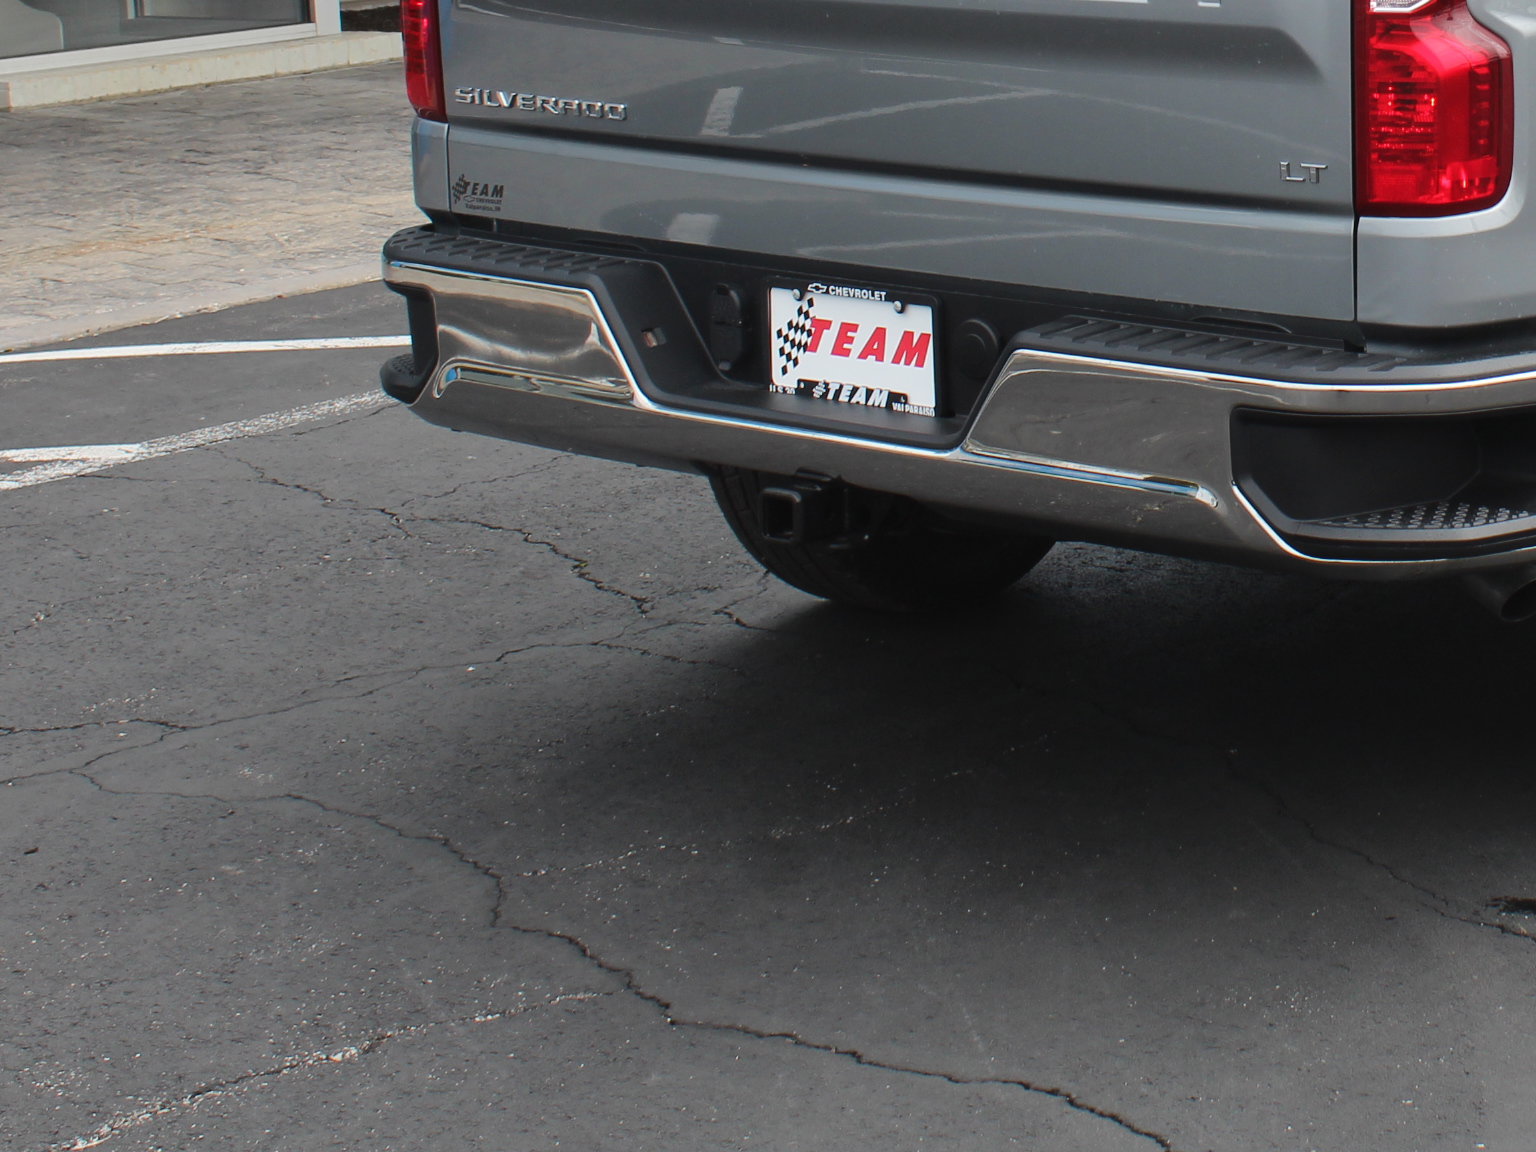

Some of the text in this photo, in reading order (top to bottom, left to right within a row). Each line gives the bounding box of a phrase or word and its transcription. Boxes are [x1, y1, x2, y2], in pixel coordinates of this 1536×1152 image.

[454, 87, 628, 121] SILVERADO
[1280, 160, 1329, 184] LT
[463, 181, 504, 198] TEAM
[828, 285, 887, 302] CHEVROLET
[806, 318, 932, 369] TEAM
[827, 382, 891, 408] TEAM
